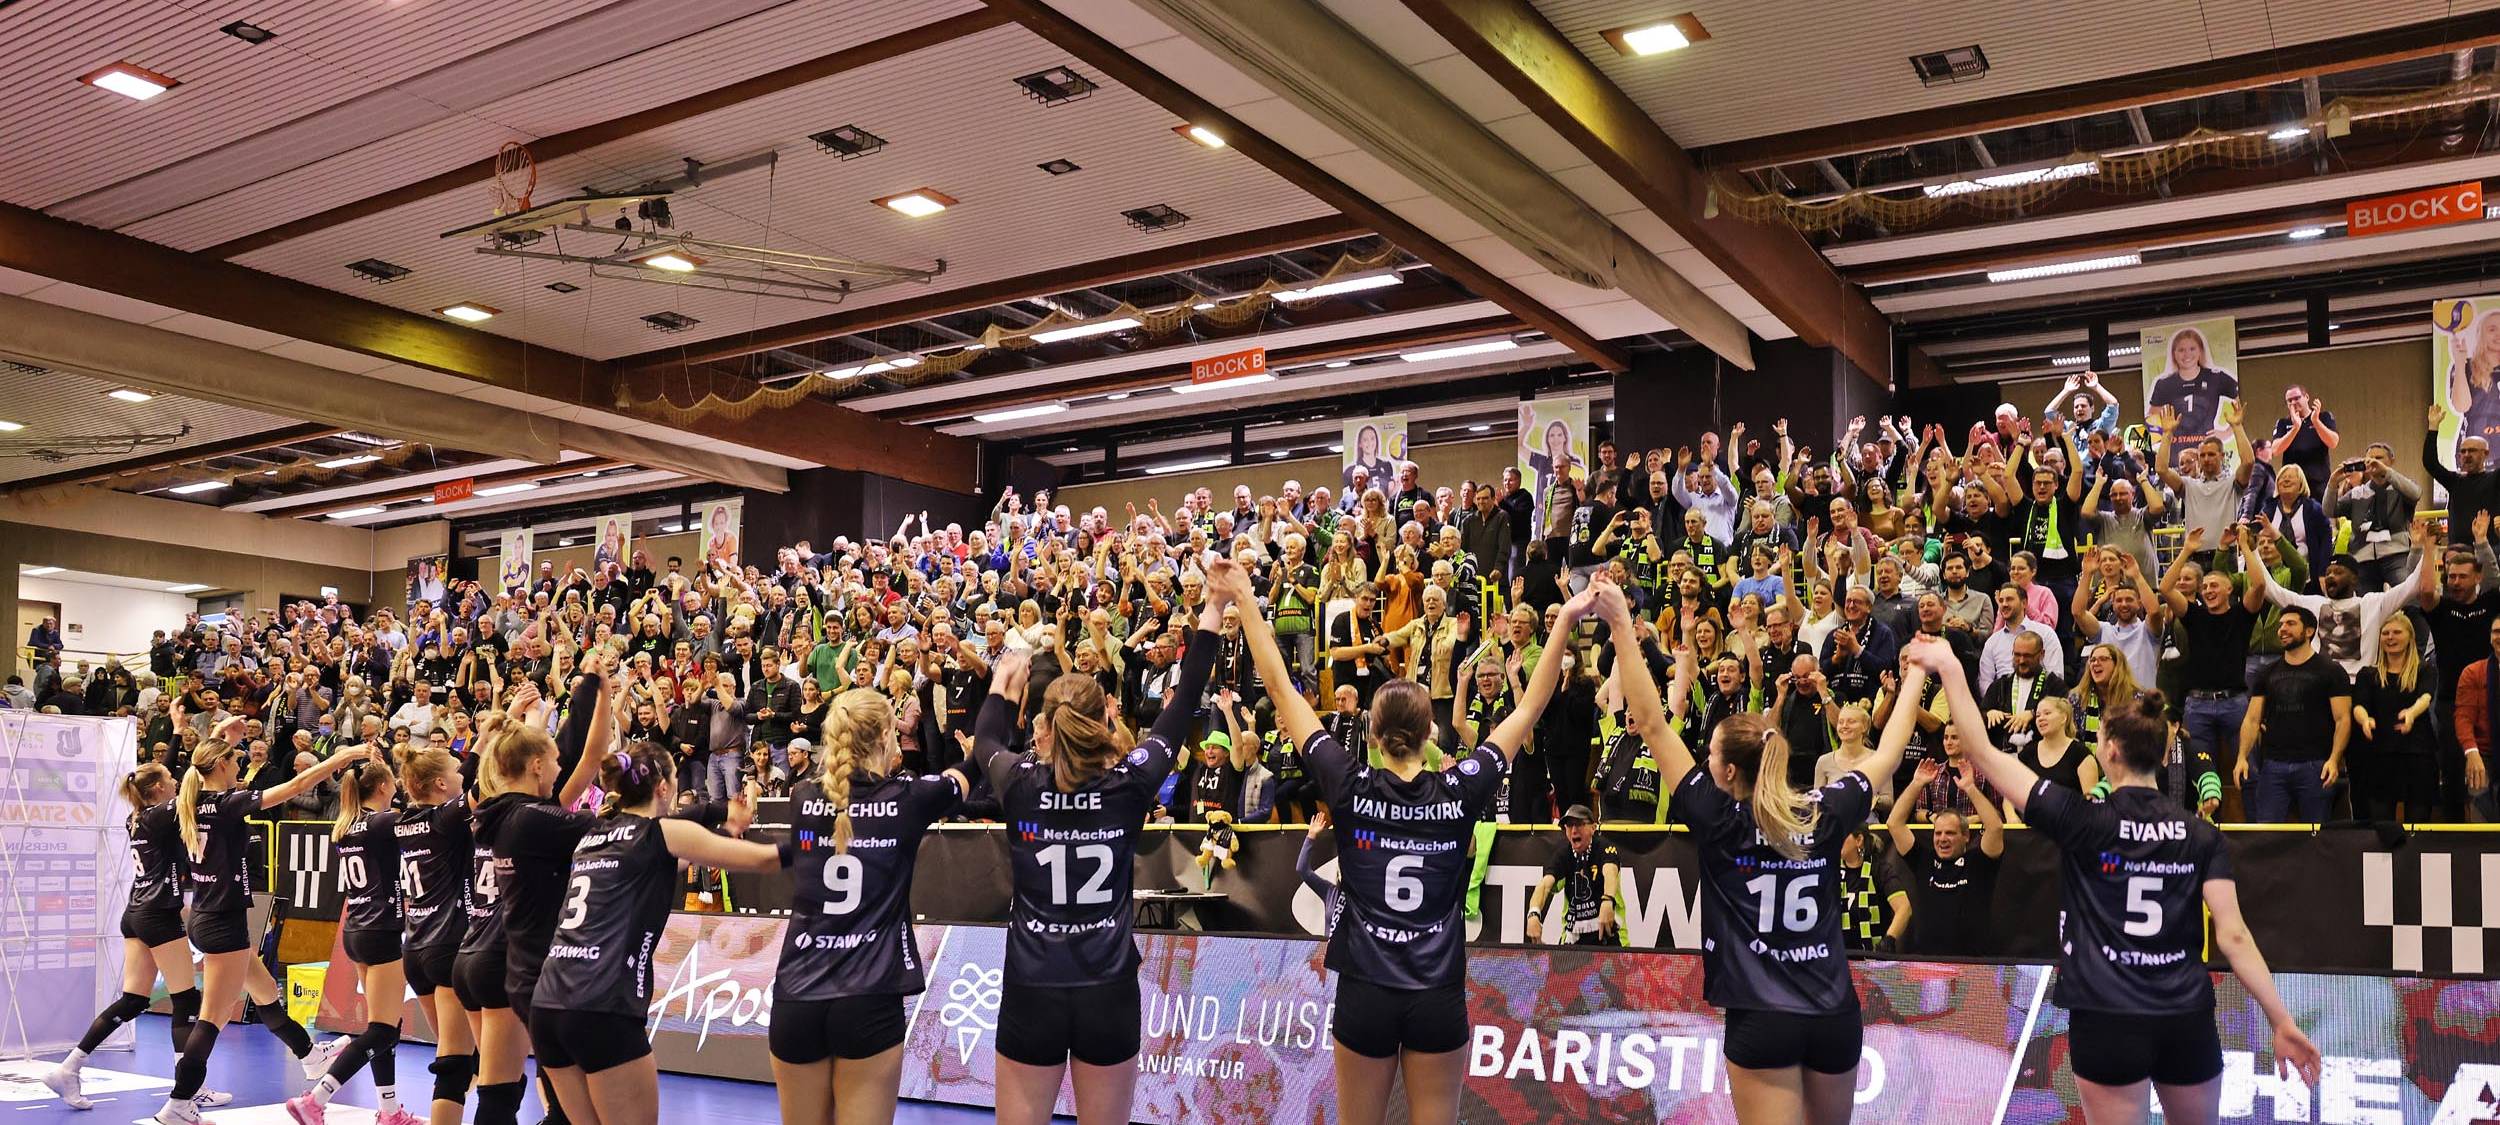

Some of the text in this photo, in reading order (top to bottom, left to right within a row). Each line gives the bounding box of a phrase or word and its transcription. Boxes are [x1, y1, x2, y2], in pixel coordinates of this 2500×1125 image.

[2354, 191, 2477, 229] BLOCK C
[1196, 353, 1263, 380] BLOCK B
[2184, 394, 2193, 412] 1
[435, 483, 472, 501] BLOCK A
[1283, 582, 1295, 607] 7
[956, 687, 964, 698] 7
[802, 798, 898, 818] DÖRCHUG
[1039, 792, 1102, 810] SILGE
[1353, 795, 1465, 821] VAN BUSKIRK
[1044, 827, 1124, 840] NetAachen
[2119, 819, 2187, 842] EVANS
[1380, 837, 1457, 851] NetAachen
[1035, 844, 1114, 905] 12
[1760, 857, 1827, 870] NetAachen
[2124, 861, 2195, 875] NetAachen
[241, 857, 250, 896] EMERSON
[822, 854, 864, 915] 9
[1384, 854, 1425, 913] 6
[559, 875, 591, 930] 3
[1745, 873, 1819, 933] 16
[2124, 876, 2163, 937] 5
[549, 945, 600, 960] STAWAG
[636, 931, 654, 998] EMERSON
[1147, 993, 1336, 1050] UND LUISE
